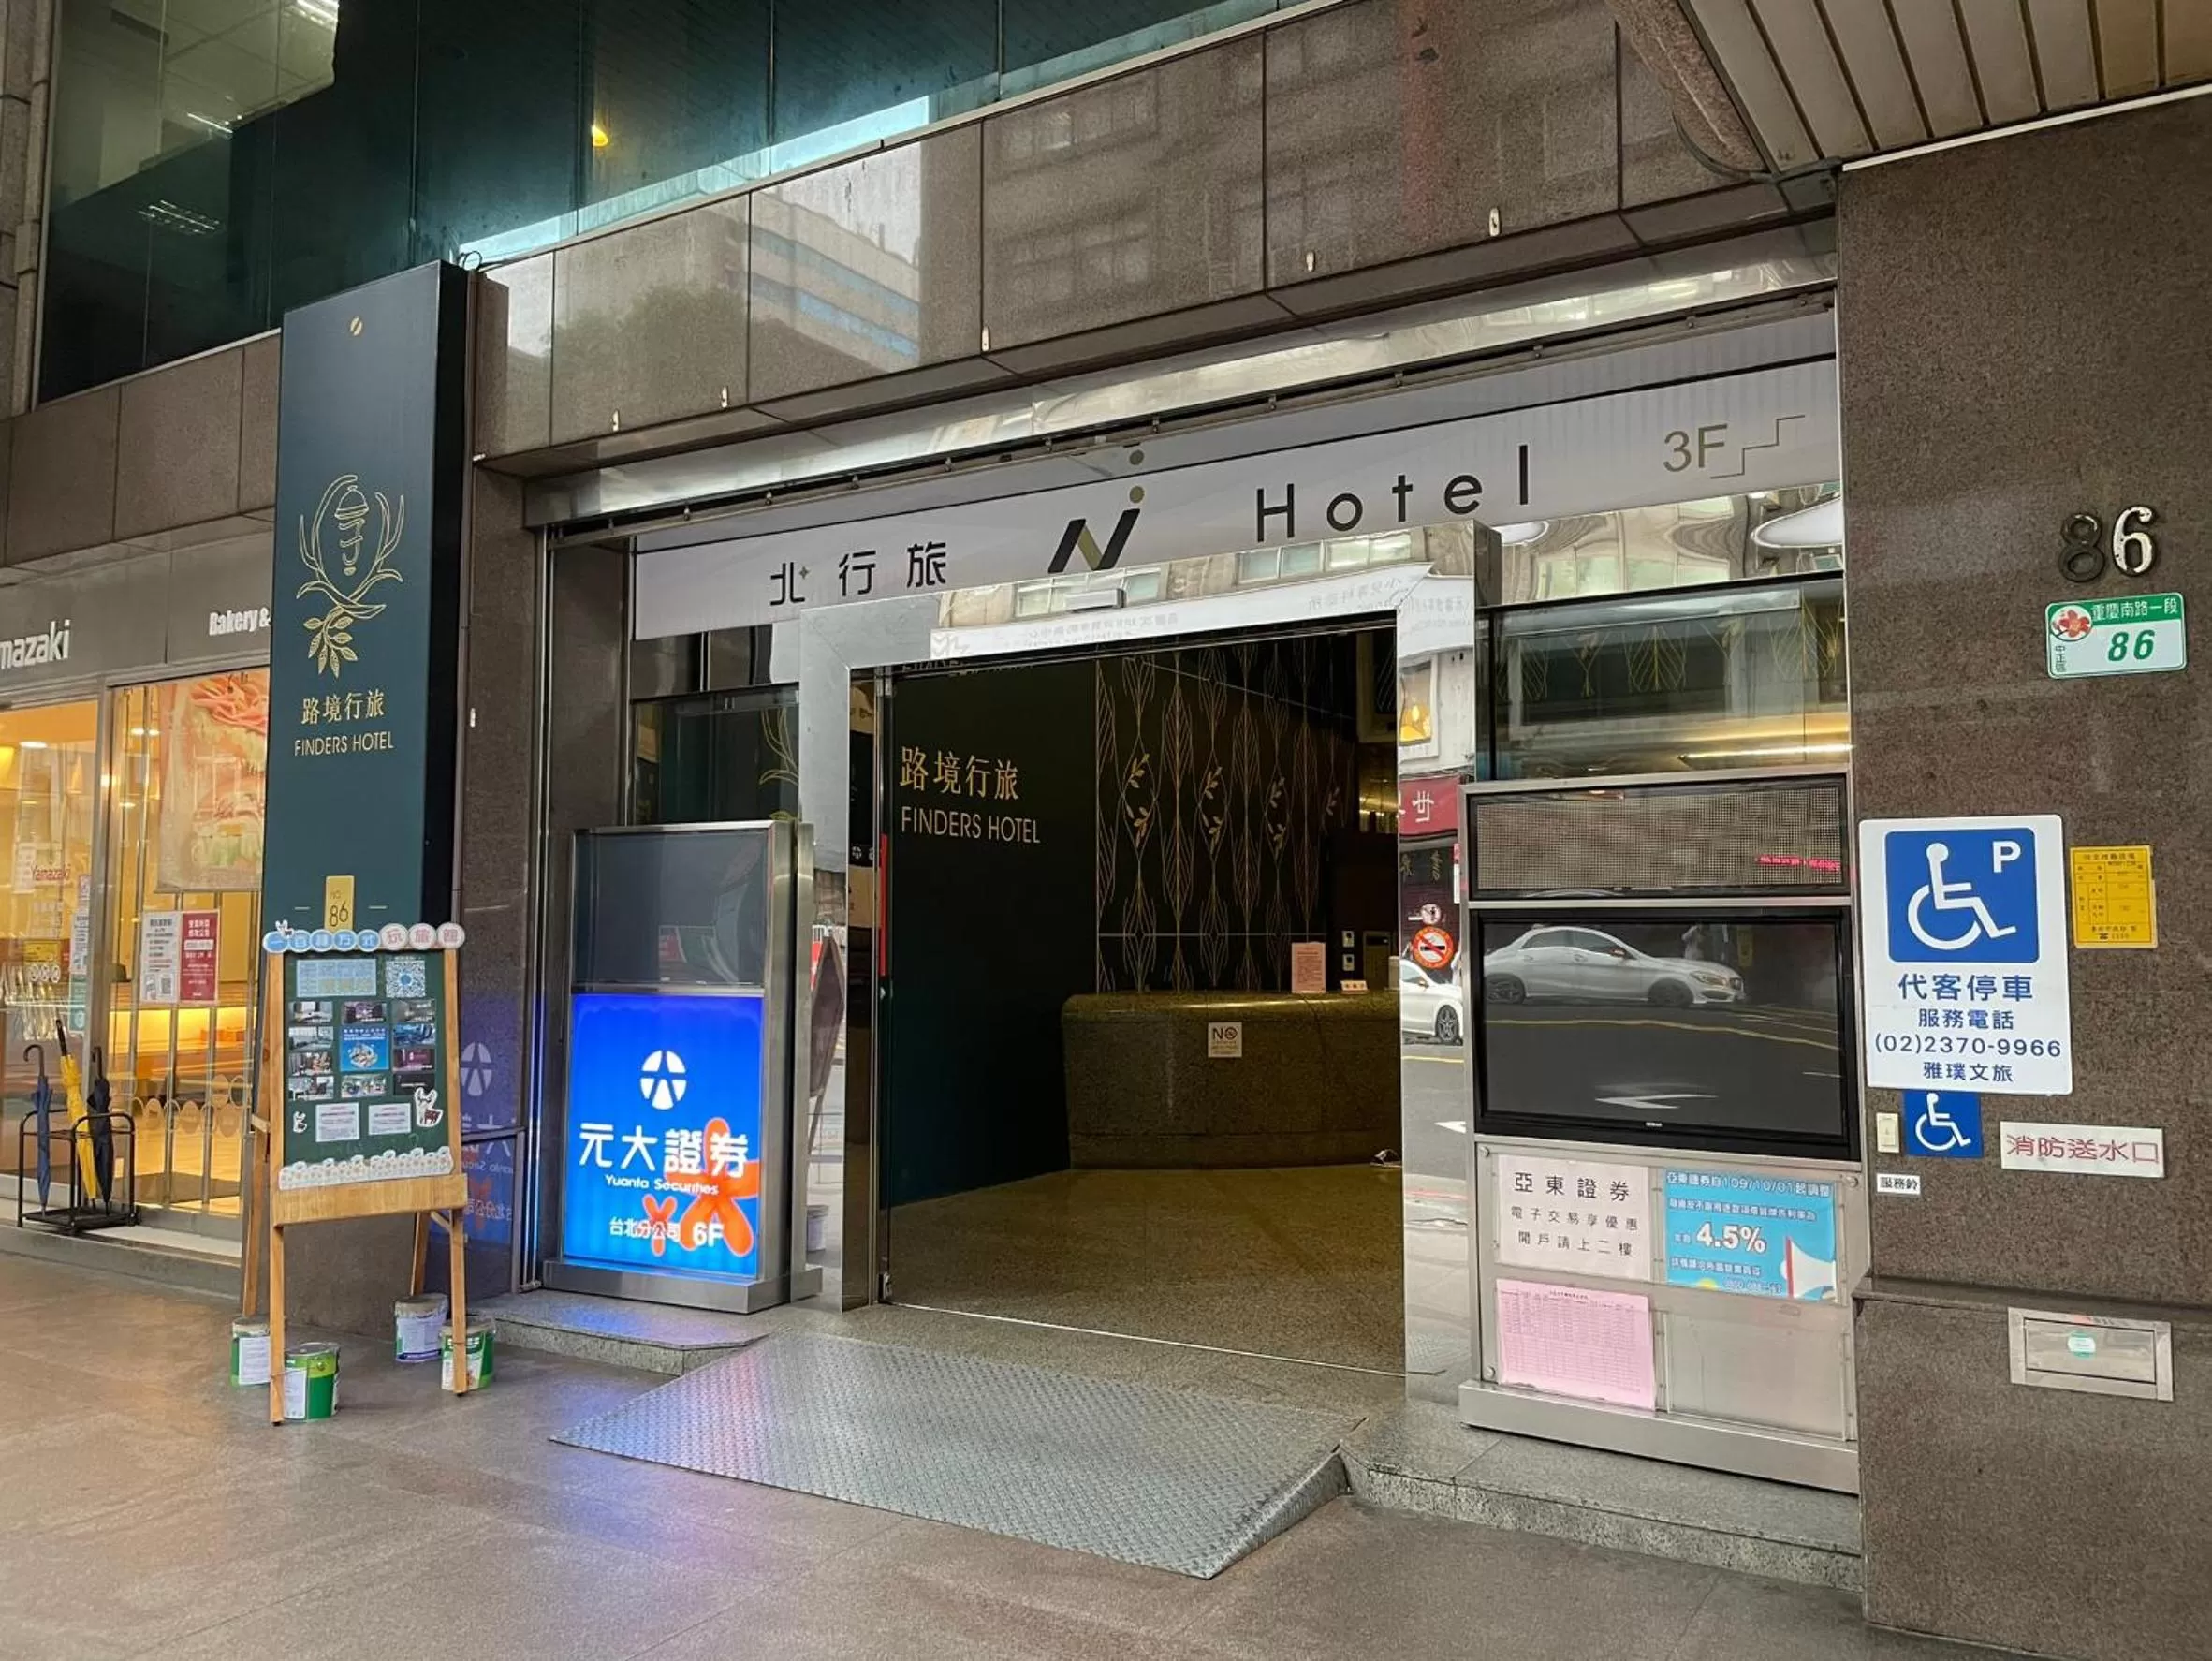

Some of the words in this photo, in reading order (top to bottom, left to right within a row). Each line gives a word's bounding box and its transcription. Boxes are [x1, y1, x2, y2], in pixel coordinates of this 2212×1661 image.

[1663, 423, 1729, 473] 3F
[770, 540, 946, 606] 北行旅
[1256, 445, 1530, 543] Hotel
[2059, 504, 2155, 582] 86
[2091, 596, 2178, 622] 重慶南路一段
[2107, 630, 2156, 662] 86
[300, 688, 386, 725] 路境行旅
[294, 734, 348, 757] FINDERS
[353, 731, 394, 752] HOTEL
[900, 746, 1018, 801] 路境行旅
[901, 806, 982, 839] FINDERS
[989, 816, 1041, 844] HOTEL
[1992, 841, 2021, 873] P
[330, 899, 349, 927] 86
[1898, 973, 2033, 1003] 代客停車
[1918, 1007, 2014, 1031] 服務電話
[1874, 1032, 2061, 1058] (02)2370-9966
[1923, 1061, 2014, 1082] 雅璞文旅
[579, 1123, 750, 1179] 元大證券
[2005, 1134, 2161, 1164] 消防送水口
[654, 1178, 719, 1196] Securities
[1513, 1170, 1631, 1202] 亞東證券
[609, 1216, 681, 1243] 台北分公司
[693, 1222, 726, 1247] 6F
[1510, 1205, 1639, 1232] 電子交易享優惠
[1696, 1221, 1766, 1254] 4.5%
